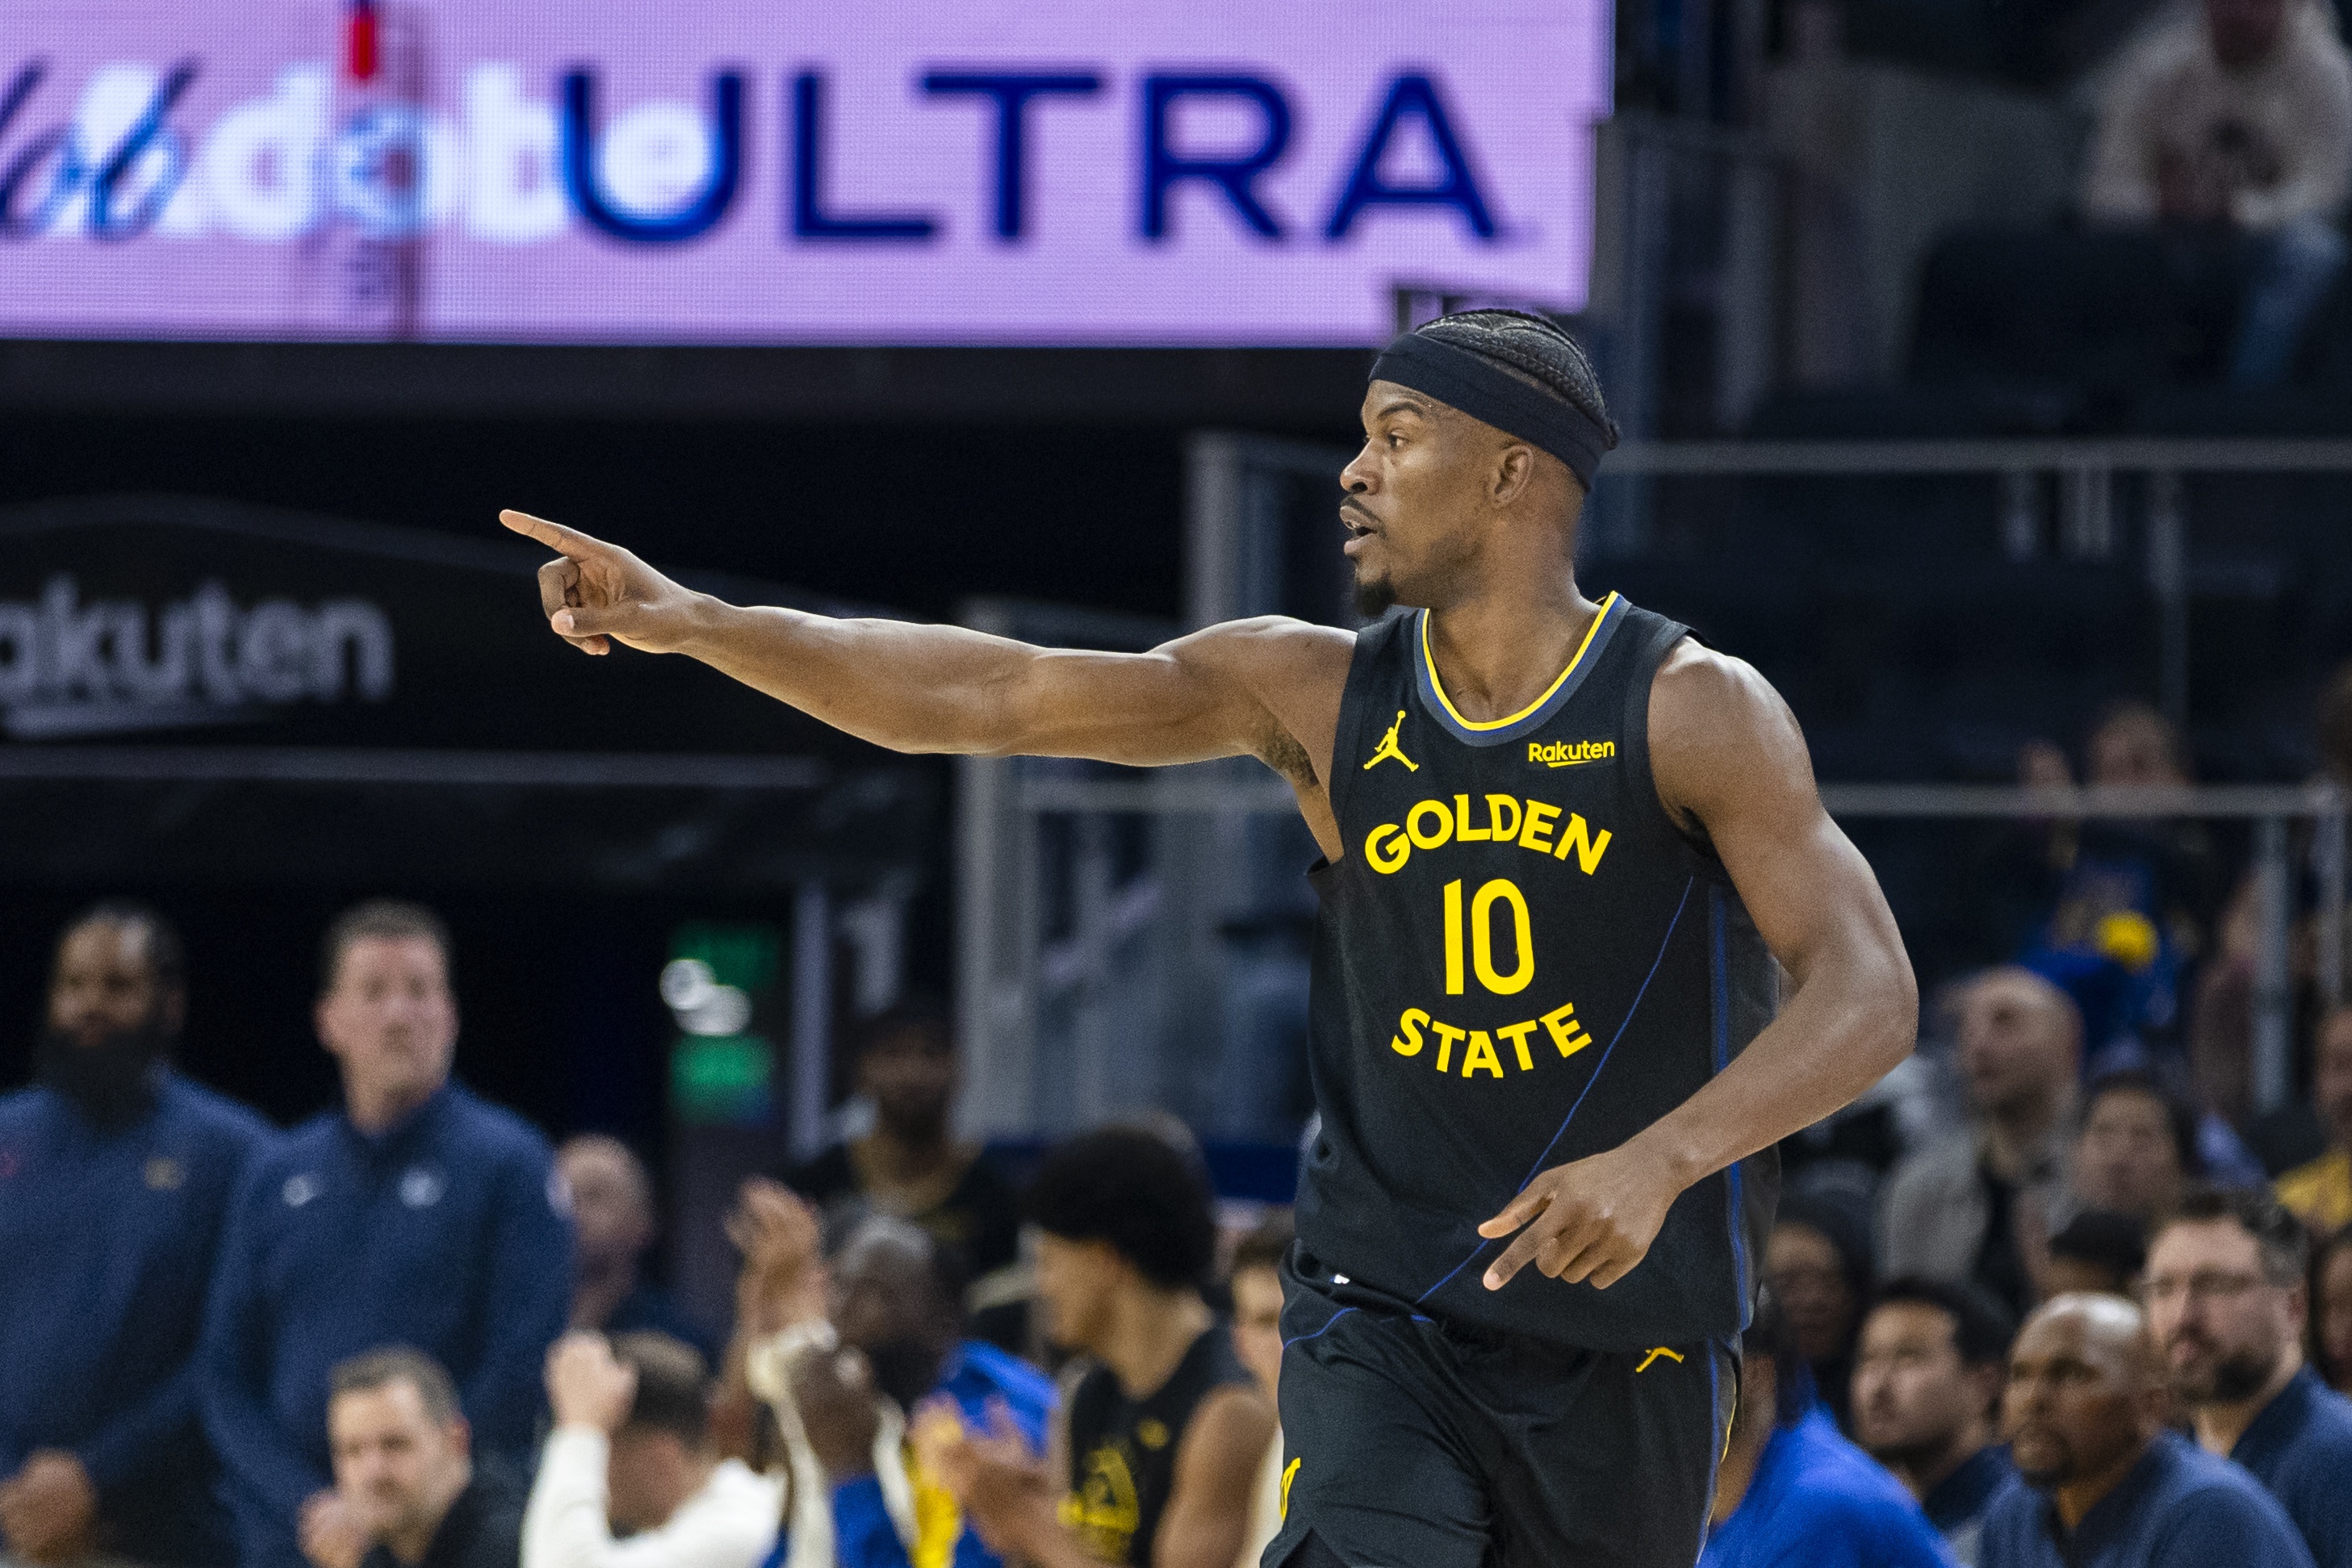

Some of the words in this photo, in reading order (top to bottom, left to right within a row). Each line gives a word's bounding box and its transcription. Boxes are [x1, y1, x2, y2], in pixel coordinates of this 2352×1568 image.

[550, 60, 1511, 253] ULTRA
[1528, 740, 1615, 768] Rakuten
[1364, 793, 1613, 876] GOLDEN
[1443, 878, 1534, 995] 10
[1391, 1002, 1592, 1078] STATE
